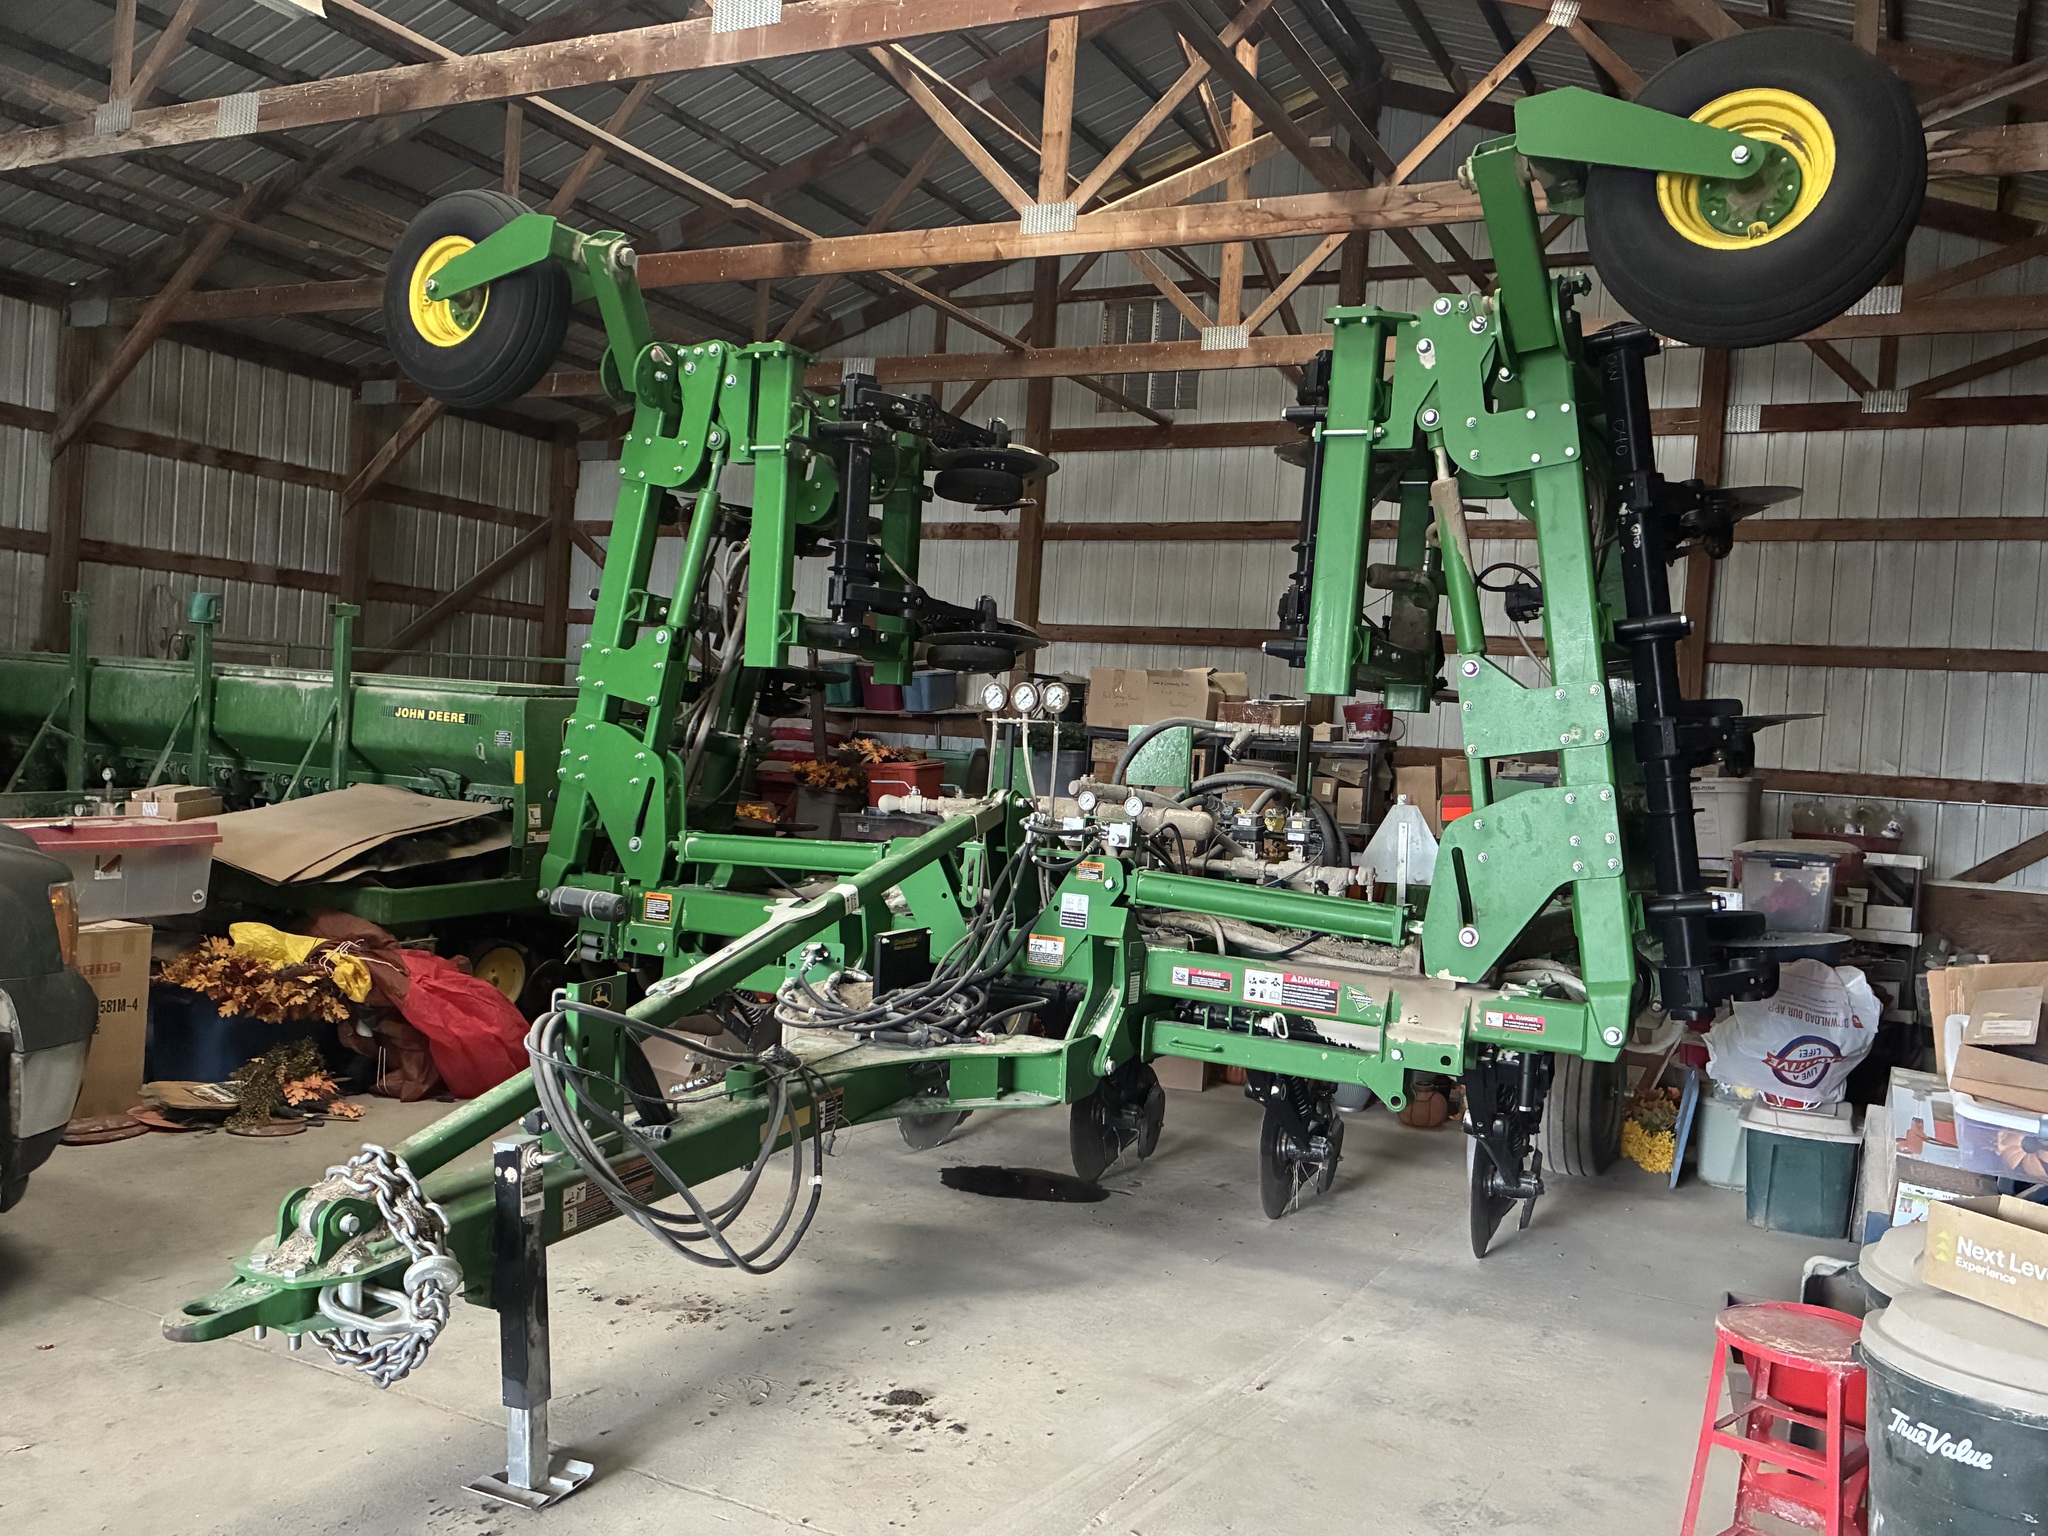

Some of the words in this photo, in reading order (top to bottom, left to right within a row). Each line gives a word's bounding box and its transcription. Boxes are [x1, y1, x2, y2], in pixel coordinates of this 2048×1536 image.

[395, 707, 425, 720] JOHN
[428, 710, 466, 723] DEERE
[1297, 975, 1331, 988] DANGER
[1768, 1002, 1786, 1014] APP
[1788, 1007, 1803, 1020] OUR
[1799, 1048, 1822, 1058] LIFE!
[1801, 1067, 1818, 1080] LIVE
[1957, 1235, 2005, 1268] Next
[1955, 1256, 2017, 1285] Experience
